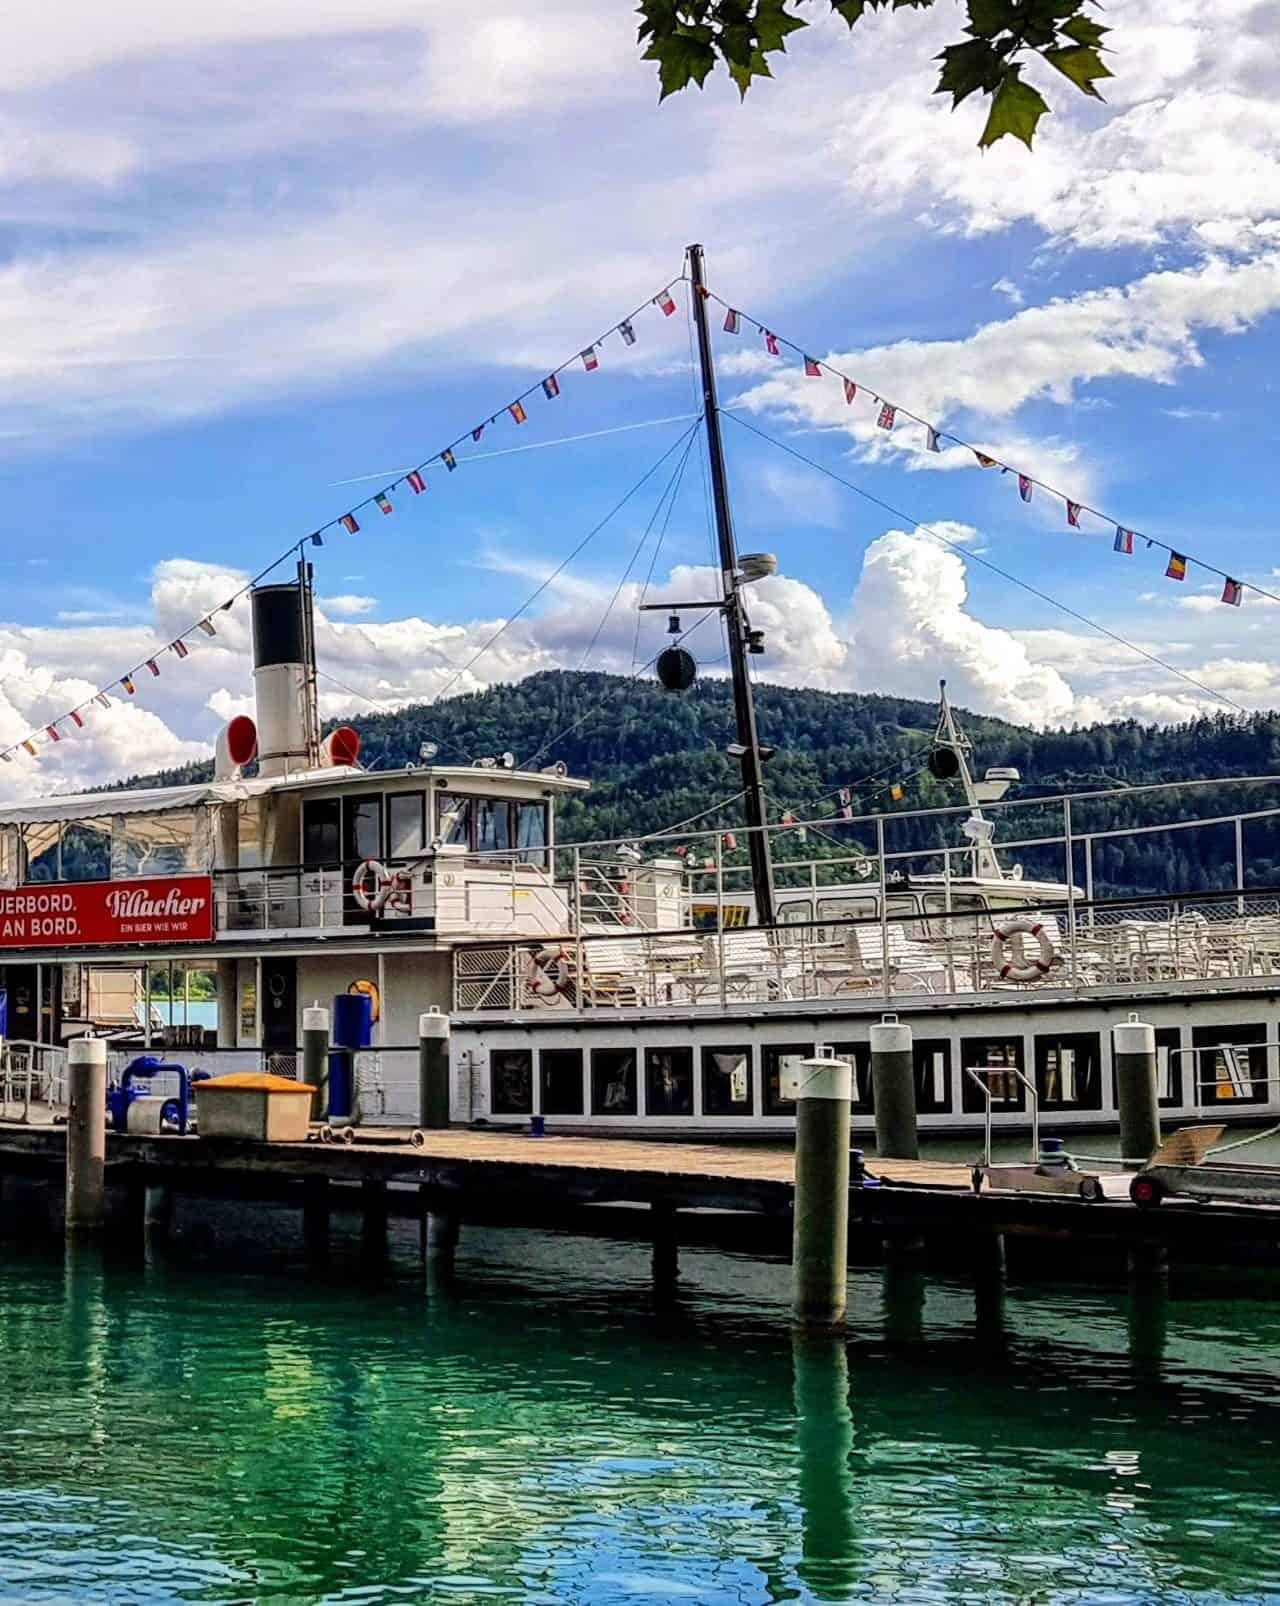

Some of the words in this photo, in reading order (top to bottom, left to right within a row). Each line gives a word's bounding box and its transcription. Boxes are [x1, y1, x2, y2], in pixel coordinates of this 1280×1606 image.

[105, 887, 206, 919] Villacher
[2, 919, 25, 937] AN
[31, 917, 81, 937] BORD.
[120, 923, 133, 934] EIN
[134, 922, 152, 934] BIER
[153, 922, 169, 933] WIE
[170, 921, 189, 932] WIR
